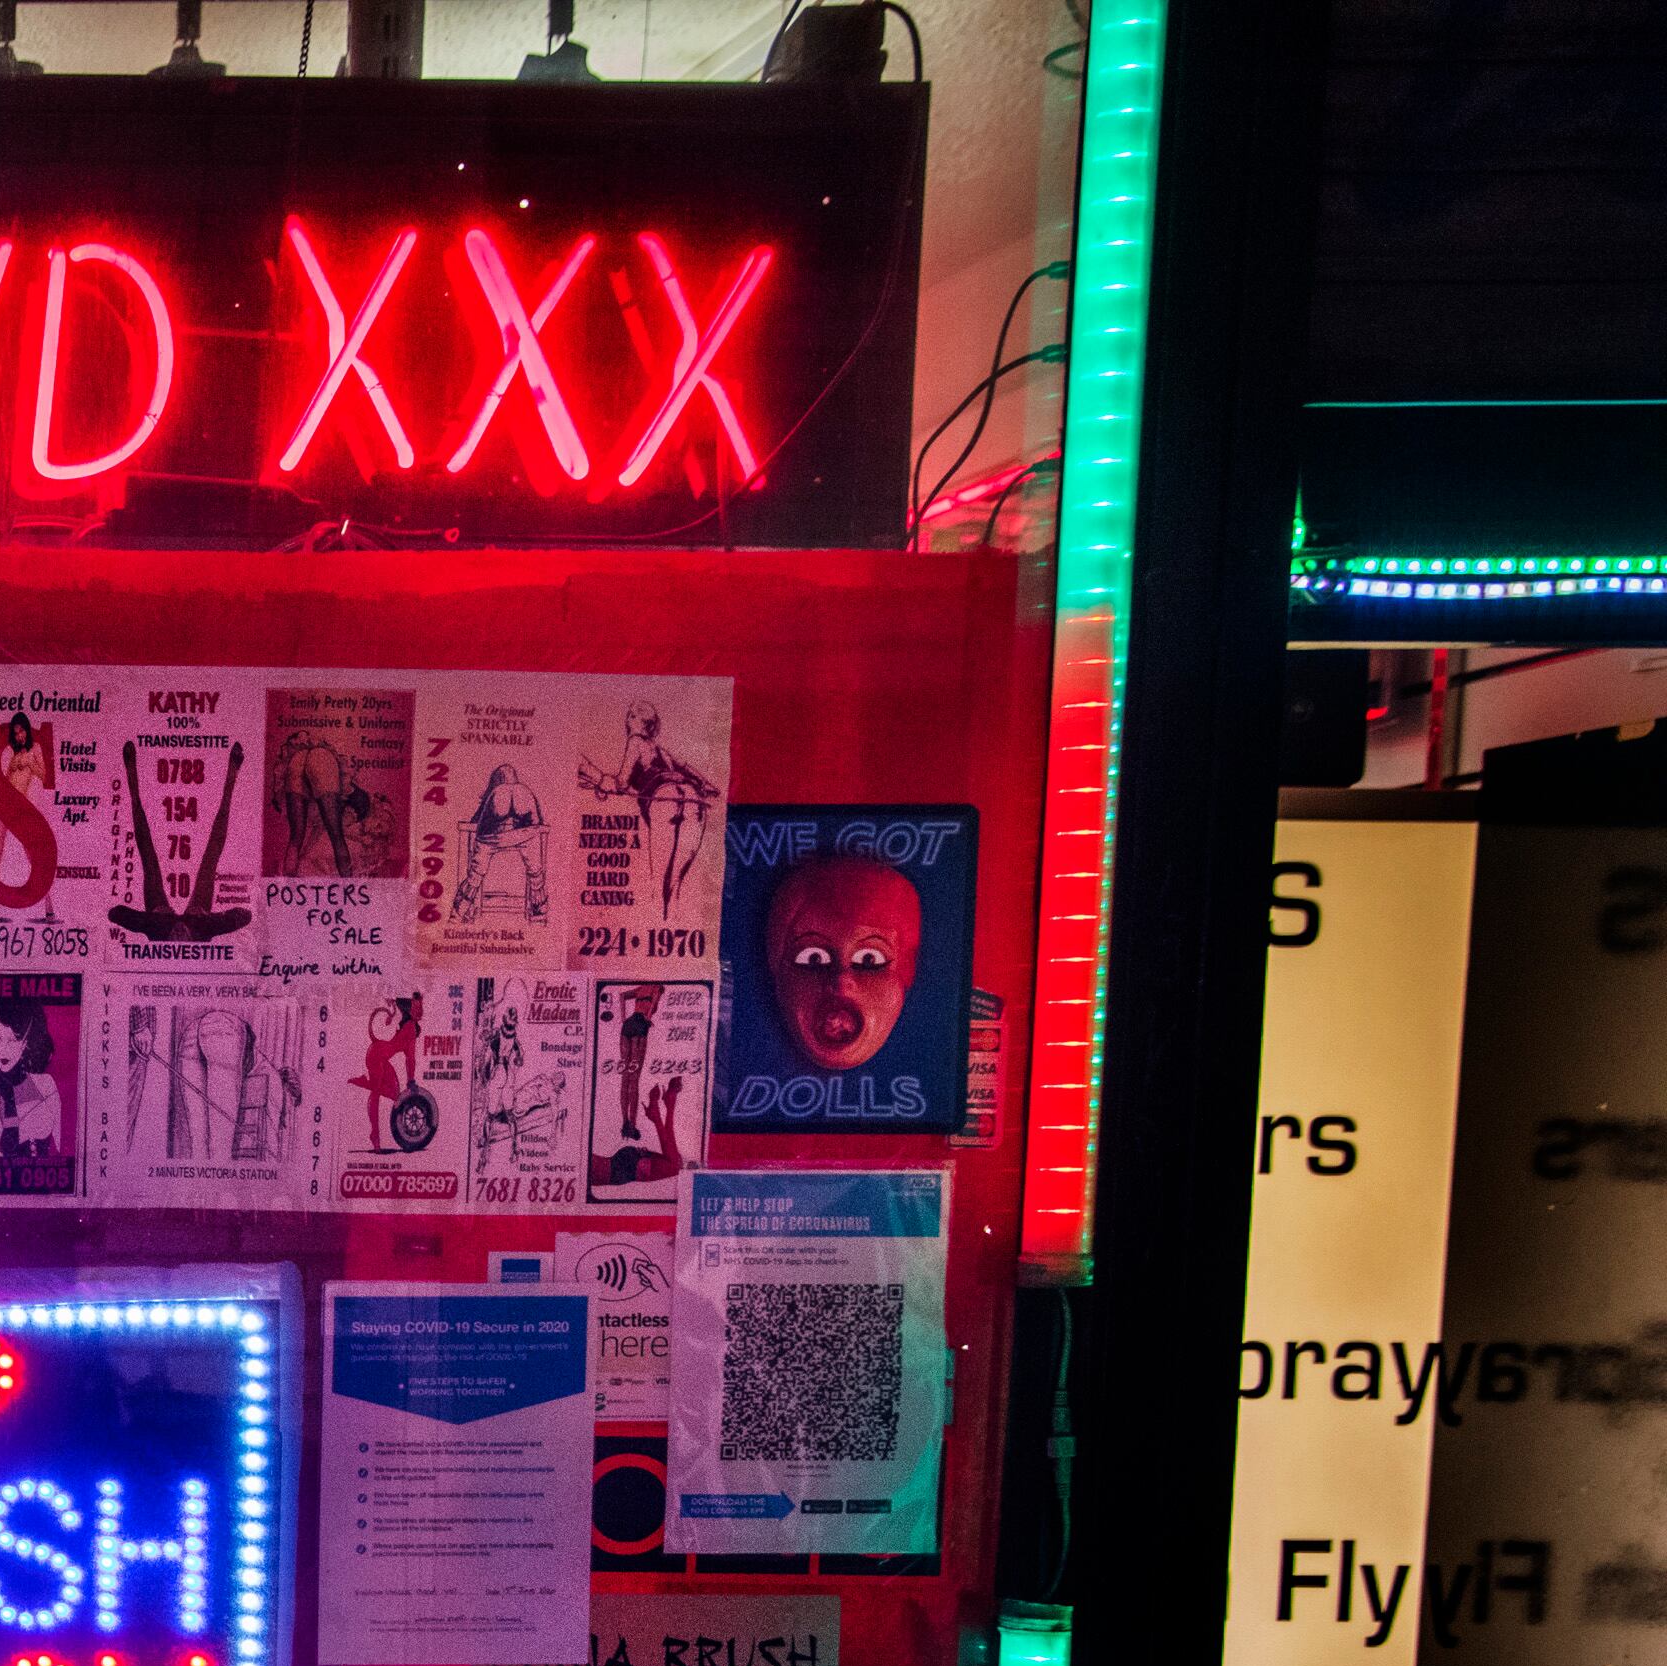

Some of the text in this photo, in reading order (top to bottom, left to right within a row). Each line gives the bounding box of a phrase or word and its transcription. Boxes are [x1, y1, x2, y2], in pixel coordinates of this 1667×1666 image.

[278, 217, 779, 489] XXX
[30, 690, 101, 714] Oriental
[148, 691, 220, 714] KATHY
[167, 716, 201, 729] 100%
[60, 741, 96, 755] Hotel
[137, 735, 229, 749] TRANSVESTITE
[60, 758, 96, 773] Visits
[54, 791, 100, 808] Luxury
[580, 814, 639, 831] BRANDI
[578, 834, 625, 849] NEEDS
[836, 822, 960, 866] GOT
[586, 852, 630, 868] GOOD
[586, 871, 629, 887] HARD
[266, 883, 370, 907] POSTERS
[307, 908, 347, 926] FOR
[329, 927, 383, 944] SALE
[122, 943, 234, 961] TRANSVESTITE
[20, 977, 74, 998] MALE
[533, 981, 577, 999] Erotic
[527, 1001, 581, 1022] Madam
[423, 1035, 462, 1056] PENNY
[728, 1074, 927, 1118] DOLLS
[343, 1175, 456, 1193] 07000 785697
[788, 1216, 871, 1232] CORONAVIRUS
[351, 1321, 570, 1336] Staying COVID-19 Secure in 2020
[600, 1330, 669, 1358] here
[1276, 1539, 1411, 1648] Fly
